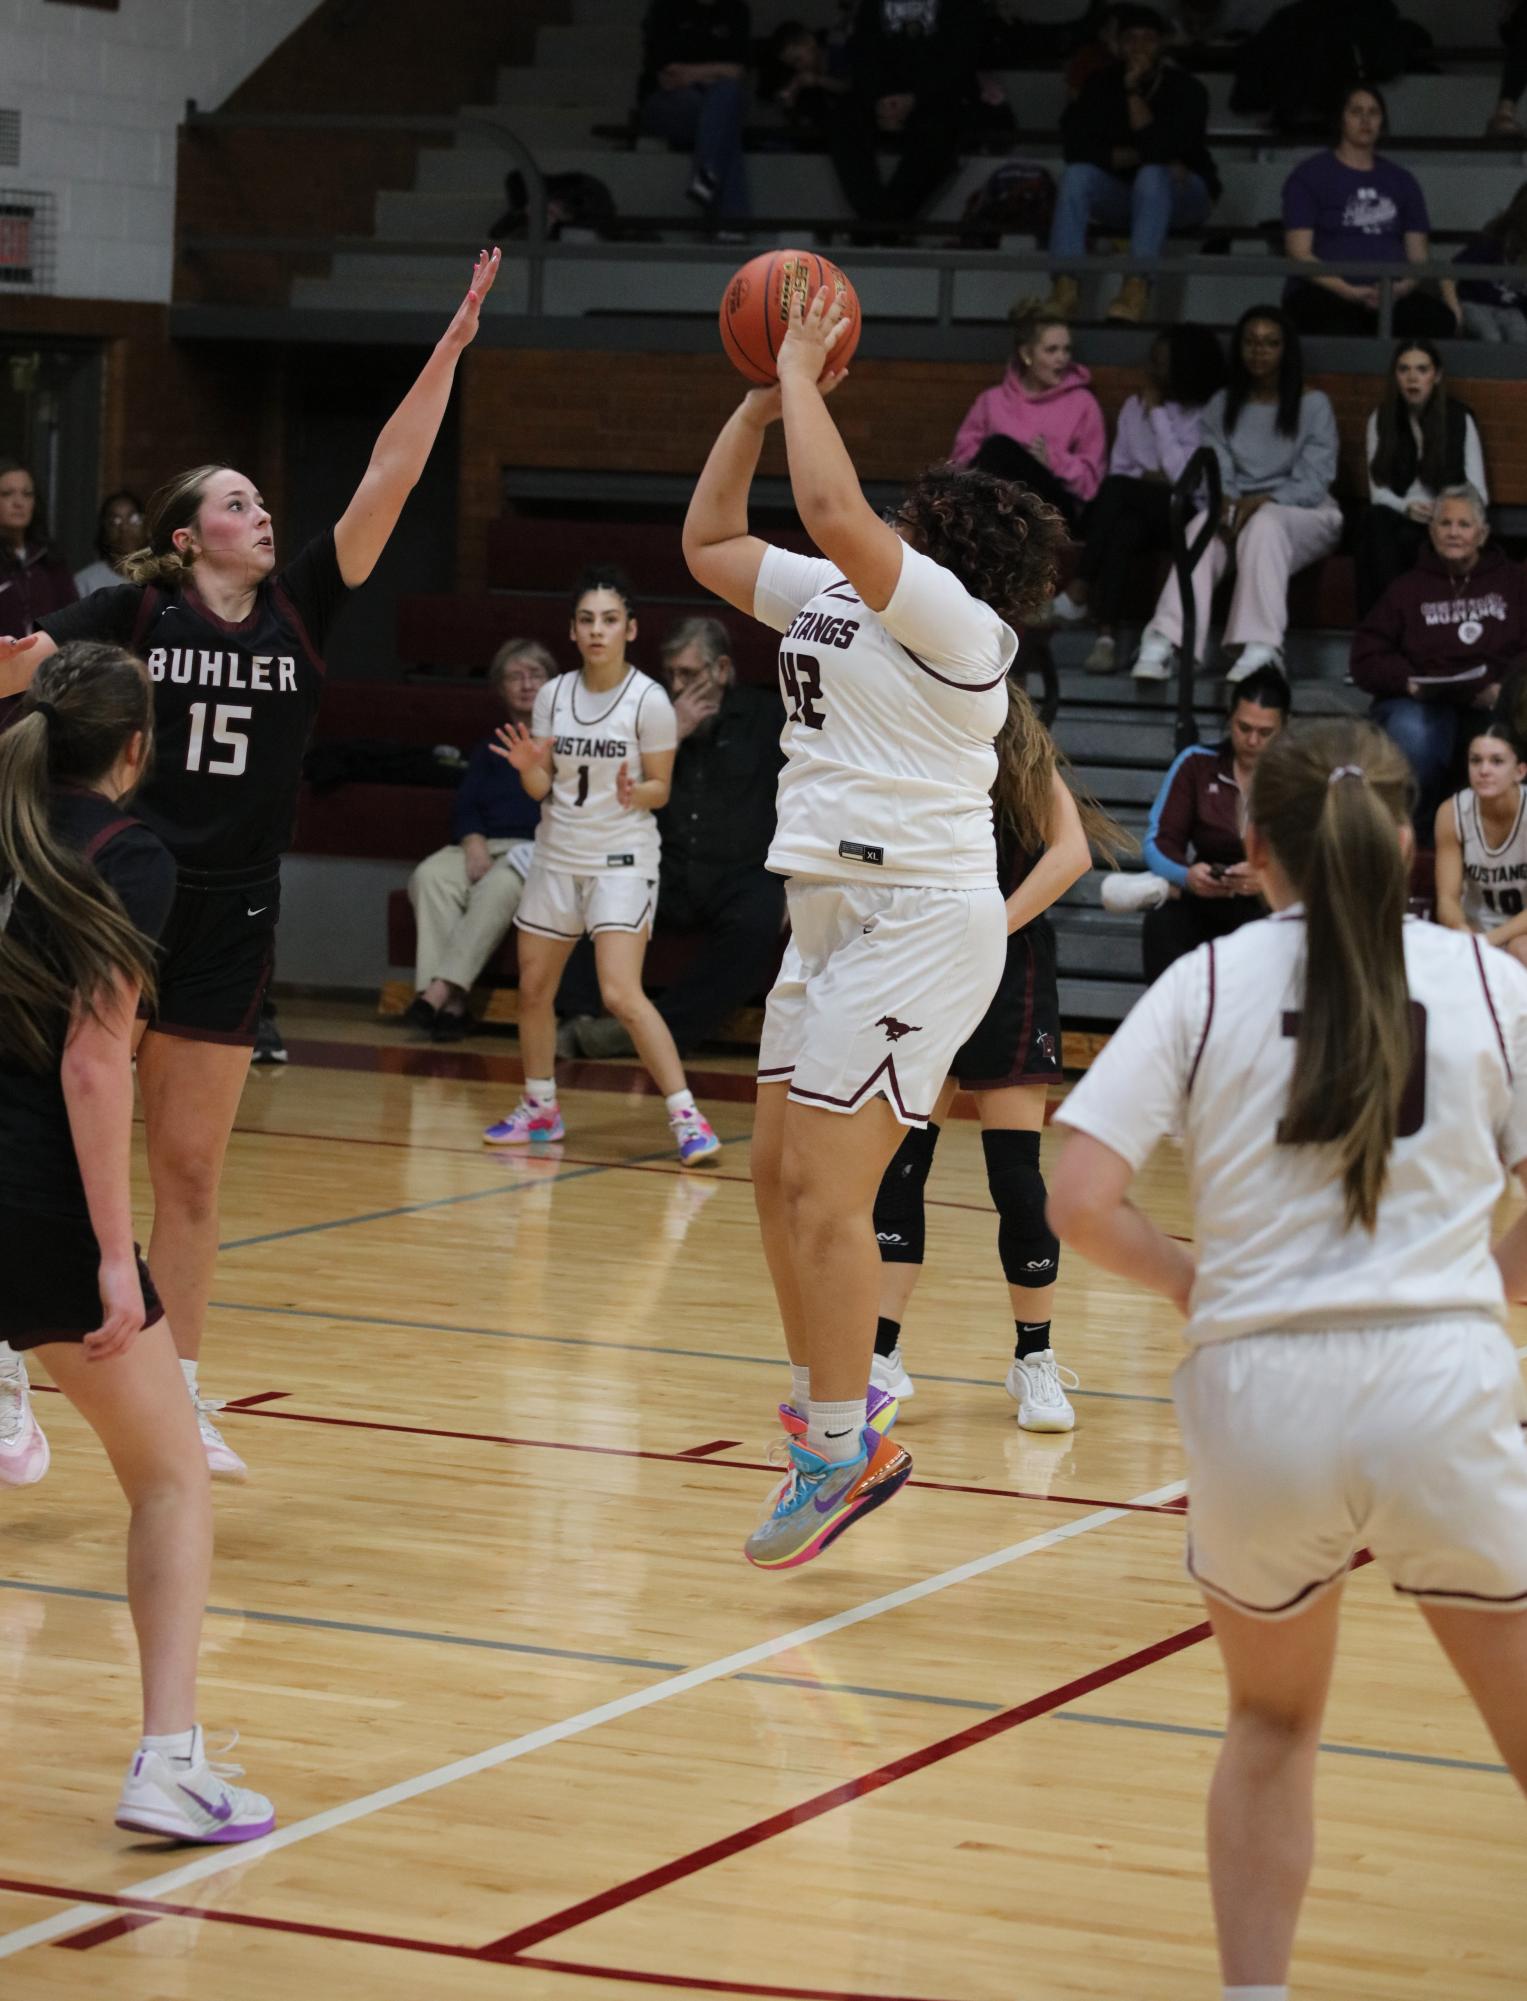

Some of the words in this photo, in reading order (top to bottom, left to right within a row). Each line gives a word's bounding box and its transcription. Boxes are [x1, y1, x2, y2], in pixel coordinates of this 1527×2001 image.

[148, 647, 298, 691] BUHLER
[779, 651, 827, 731] 42
[186, 702, 252, 776] 15
[553, 735, 627, 758] USTANGS
[574, 764, 589, 807] 1
[867, 851, 879, 860] XL
[1482, 887, 1524, 917] 10
